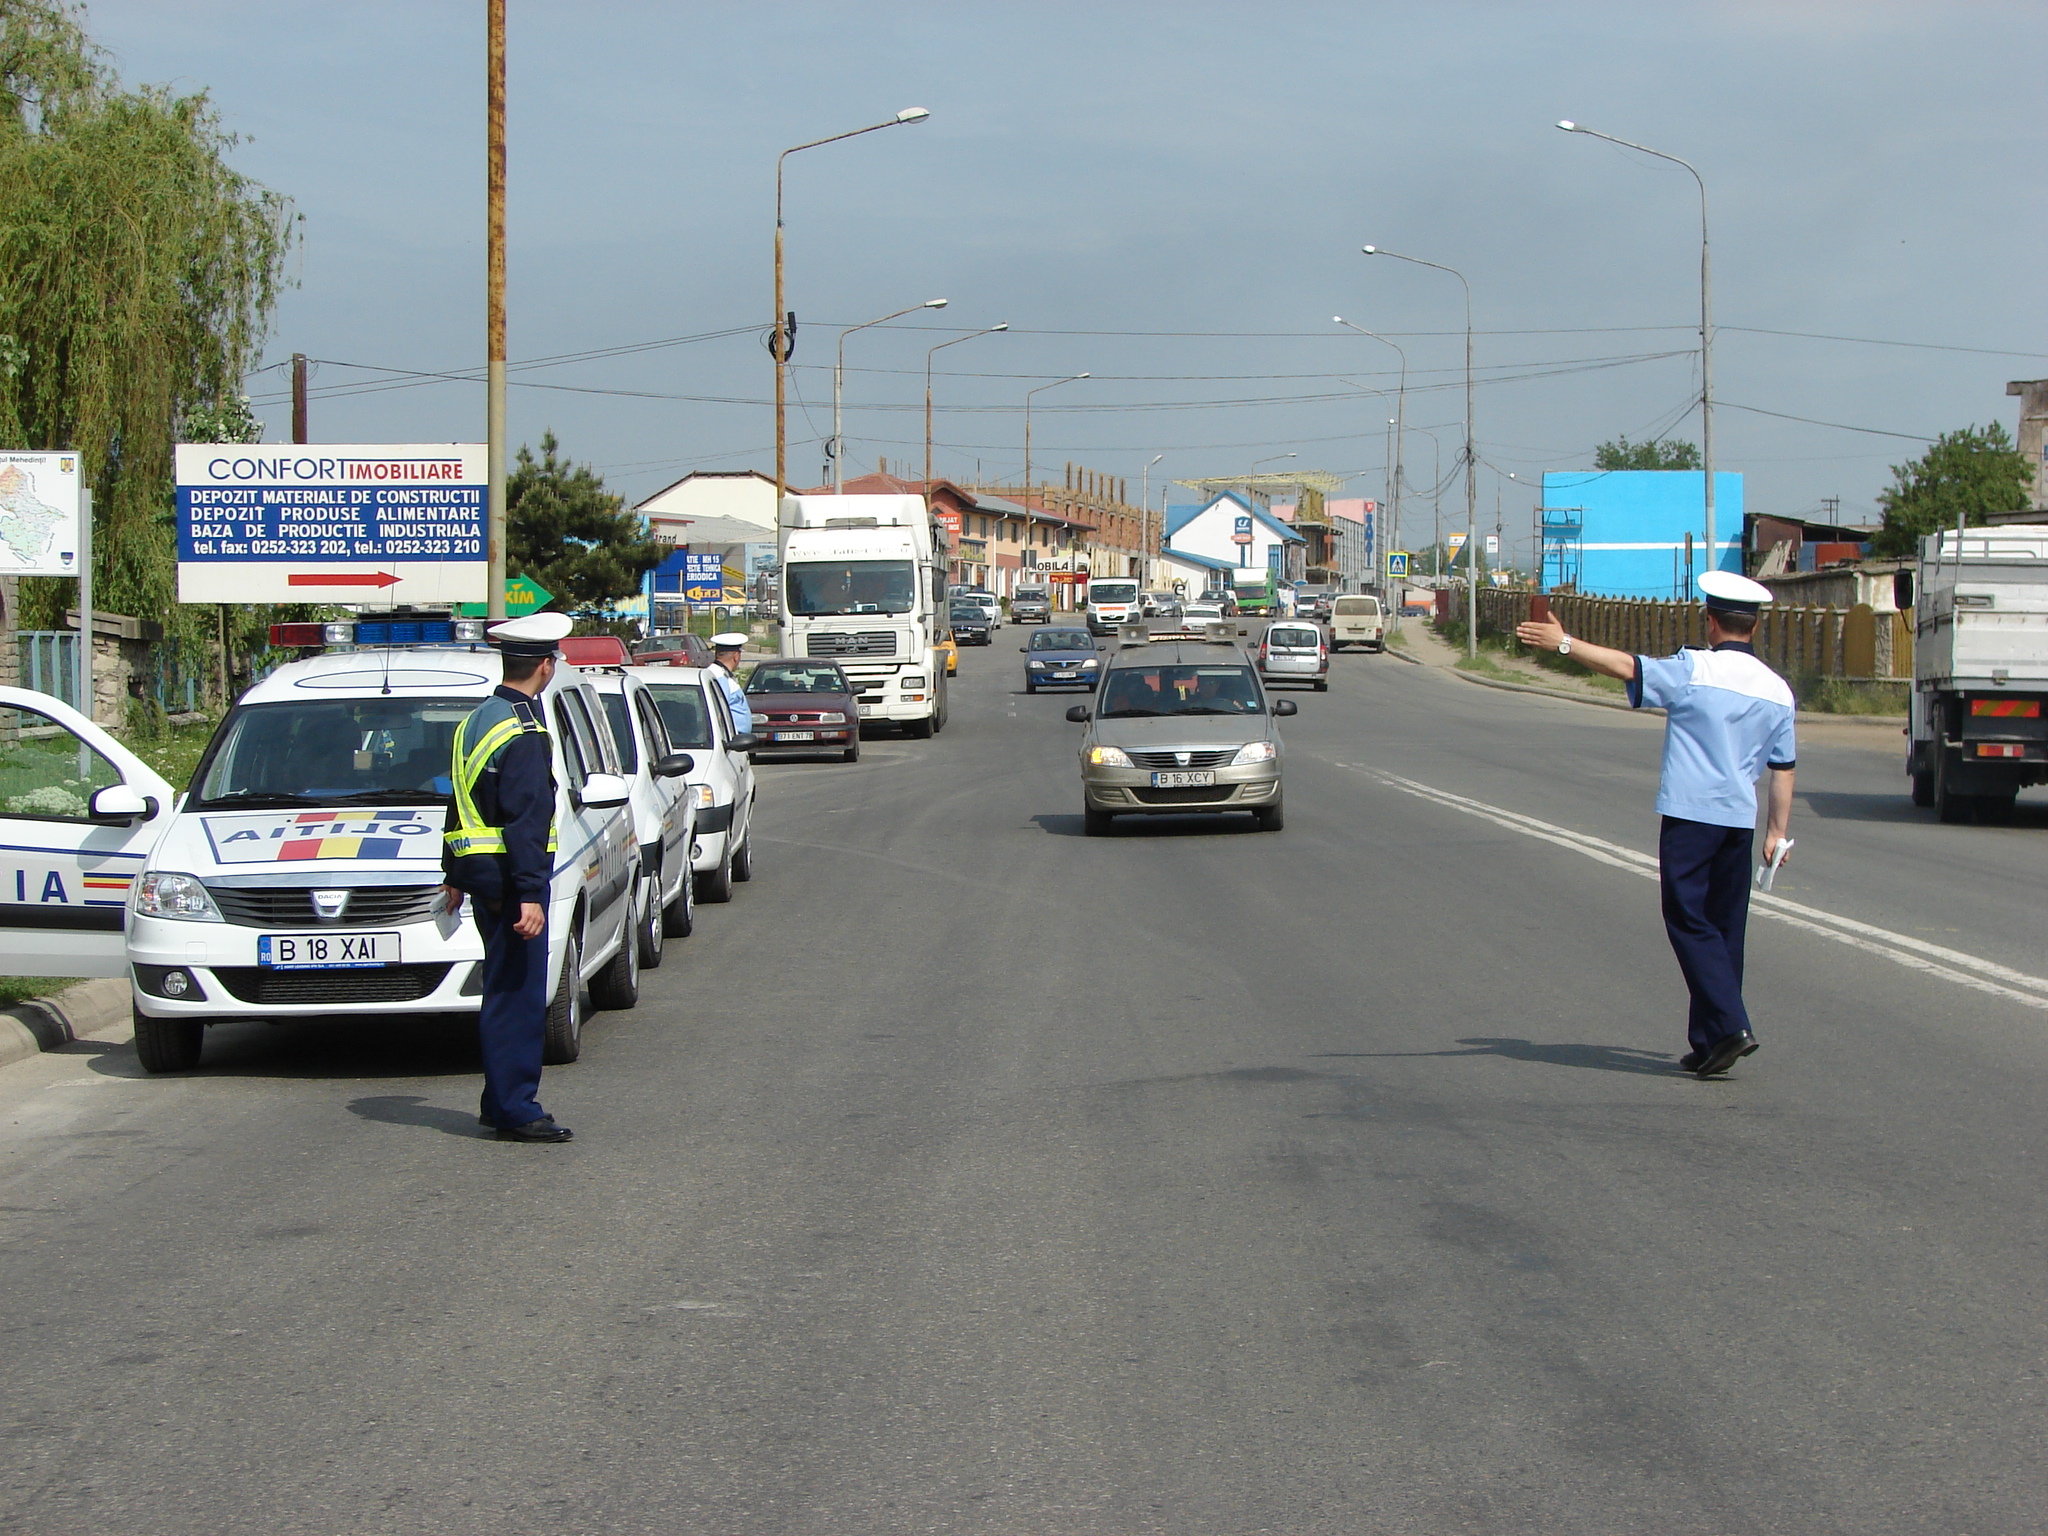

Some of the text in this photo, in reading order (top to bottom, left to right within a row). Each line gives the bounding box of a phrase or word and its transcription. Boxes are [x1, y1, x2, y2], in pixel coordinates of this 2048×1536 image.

[208, 458, 463, 480] CONFORT IMOBILIARE
[190, 489, 480, 504] DEPOZIT MATERIALE DE CONSTRUCTII
[190, 506, 480, 521] DEPOZIT PRODUSE ALIMENTARE
[191, 523, 481, 538] BAZA DE PRODUCTIE INDUSTRIALA
[193, 539, 480, 558] tel. fax: 0252-323 202, tel.: 0252-323 210
[835, 637, 868, 645] MAN
[1160, 773, 1209, 784] B 16 XCY
[260, 937, 376, 962] RO B 18 XAI
